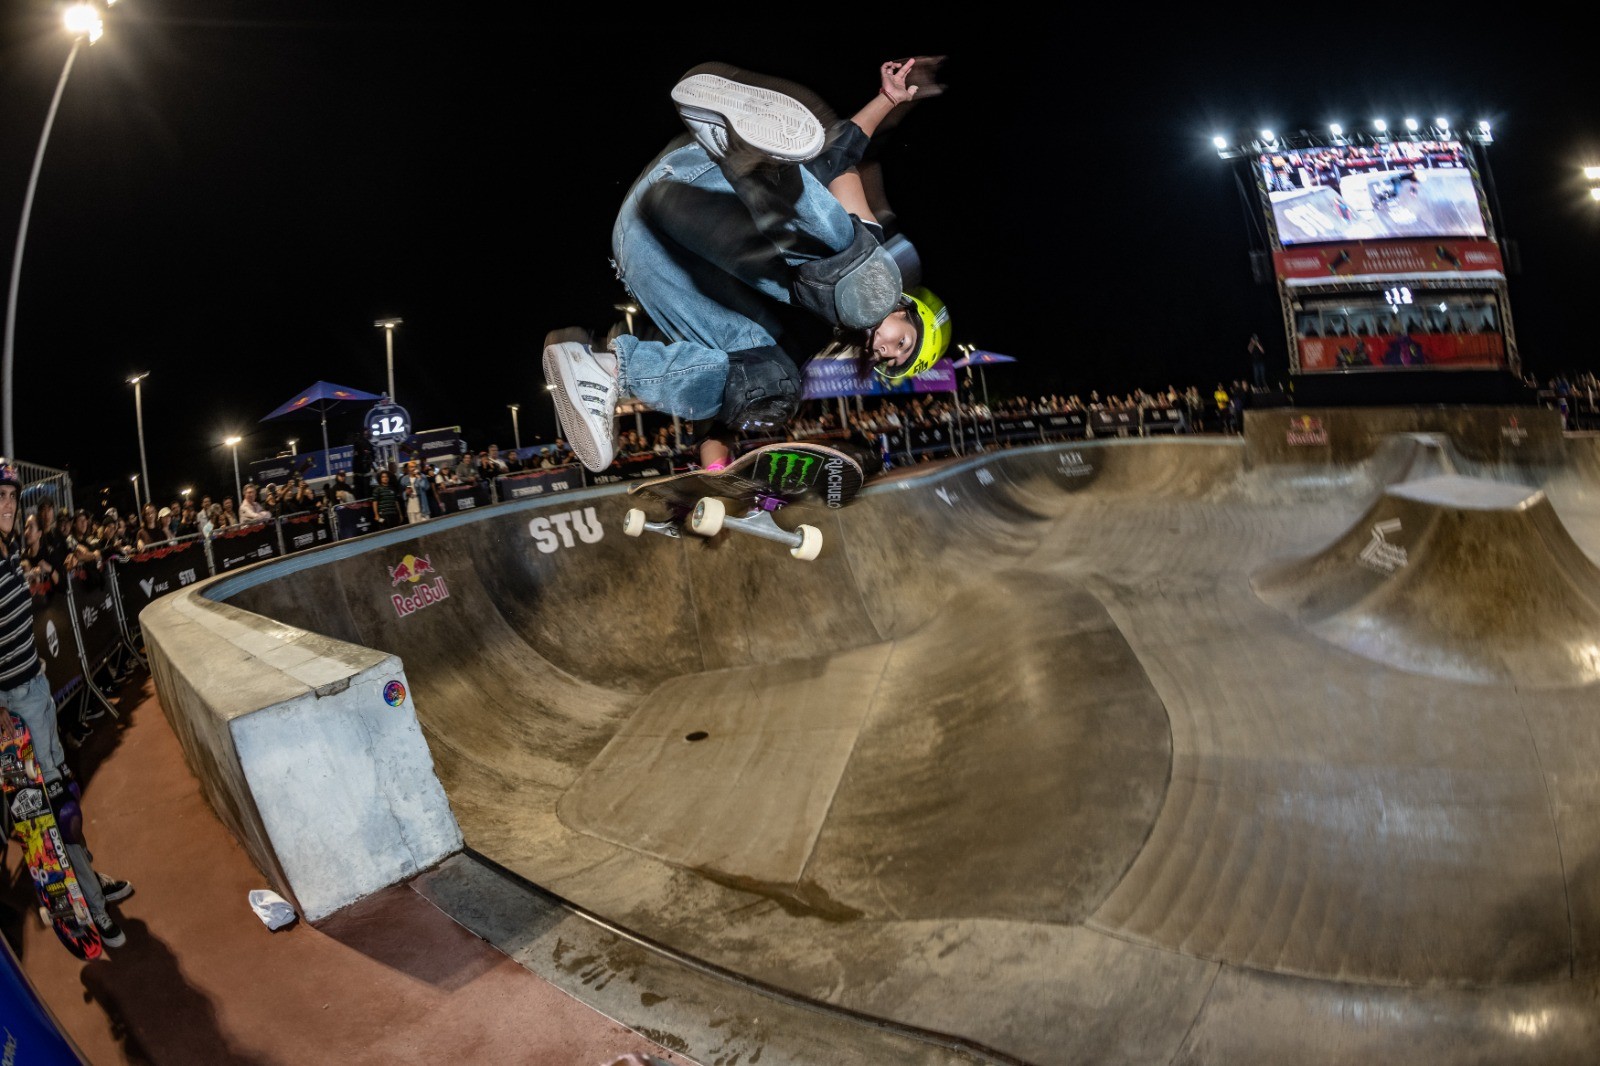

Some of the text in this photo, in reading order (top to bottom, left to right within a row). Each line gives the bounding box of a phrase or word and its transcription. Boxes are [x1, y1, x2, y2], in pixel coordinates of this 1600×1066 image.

[551, 481, 569, 492] STU
[824, 458, 844, 509] RIACHUELO
[529, 506, 604, 554] STU
[178, 567, 197, 586] STU
